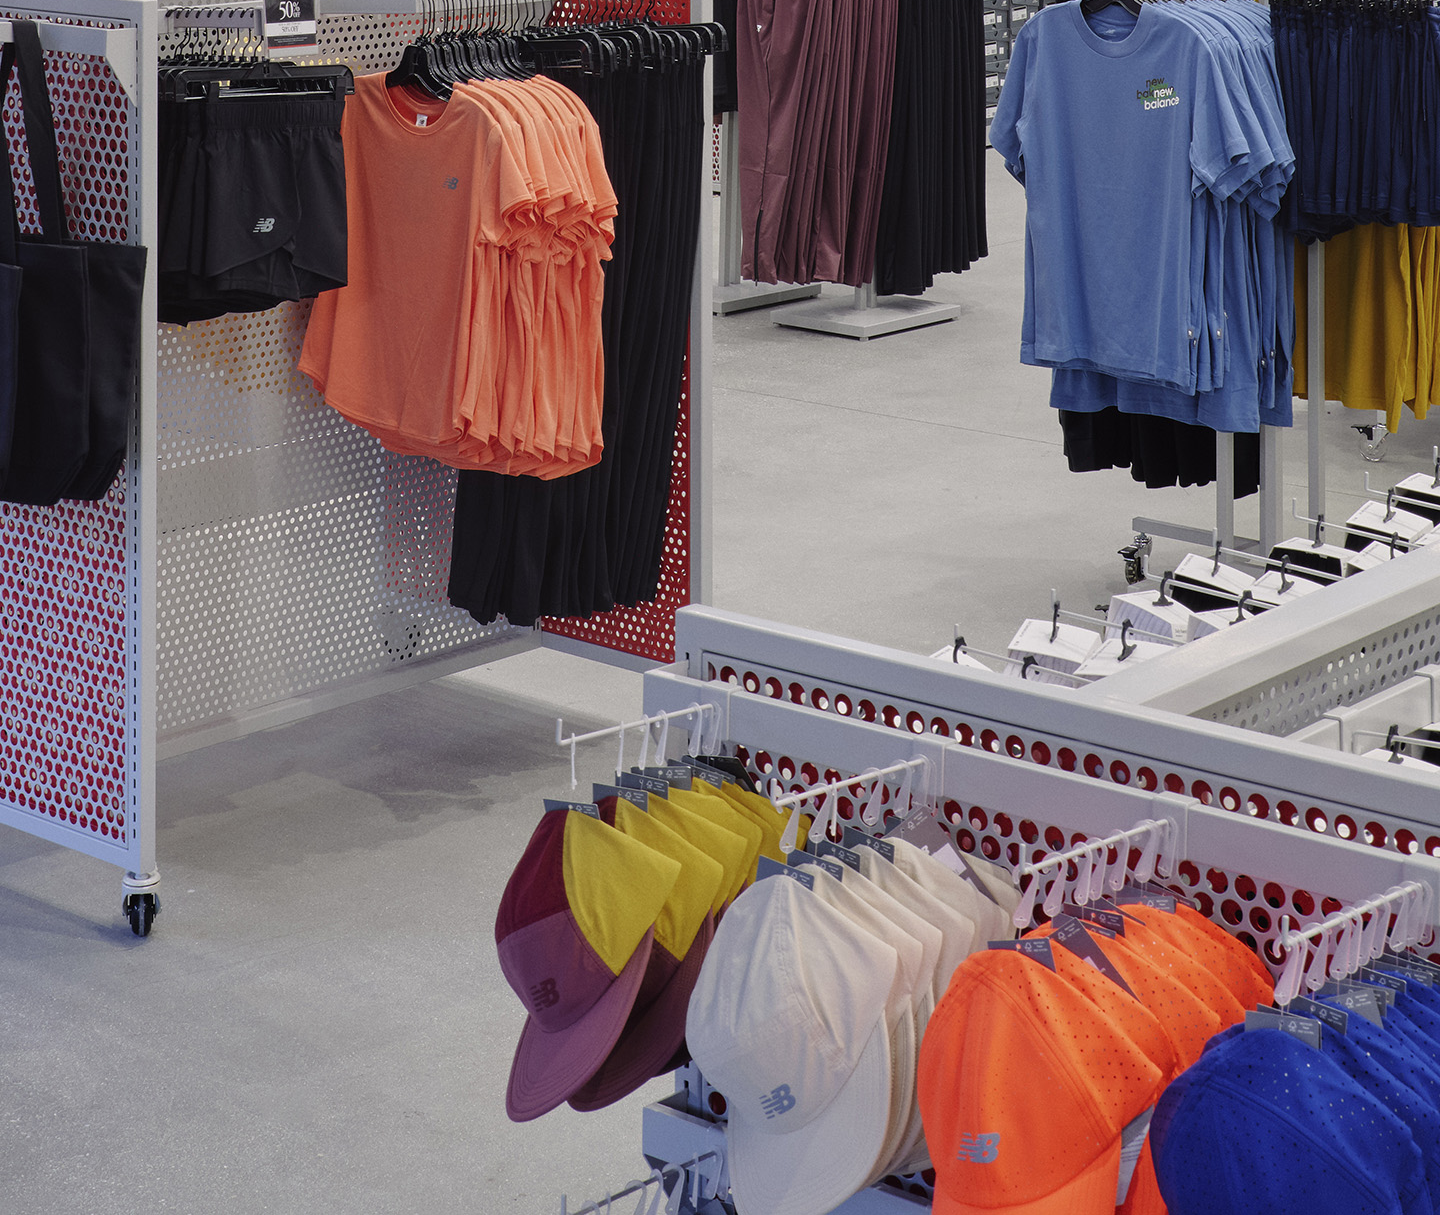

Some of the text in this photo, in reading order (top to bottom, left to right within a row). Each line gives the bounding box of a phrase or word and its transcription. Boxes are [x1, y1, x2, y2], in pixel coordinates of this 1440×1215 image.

[280, 1, 300, 20] 50%
[1146, 77, 1164, 88] new
[1154, 87, 1174, 98] new
[1144, 96, 1180, 110] balance
[253, 218, 275, 233] NB
[760, 1084, 796, 1118] NB
[956, 1132, 999, 1164] NB
